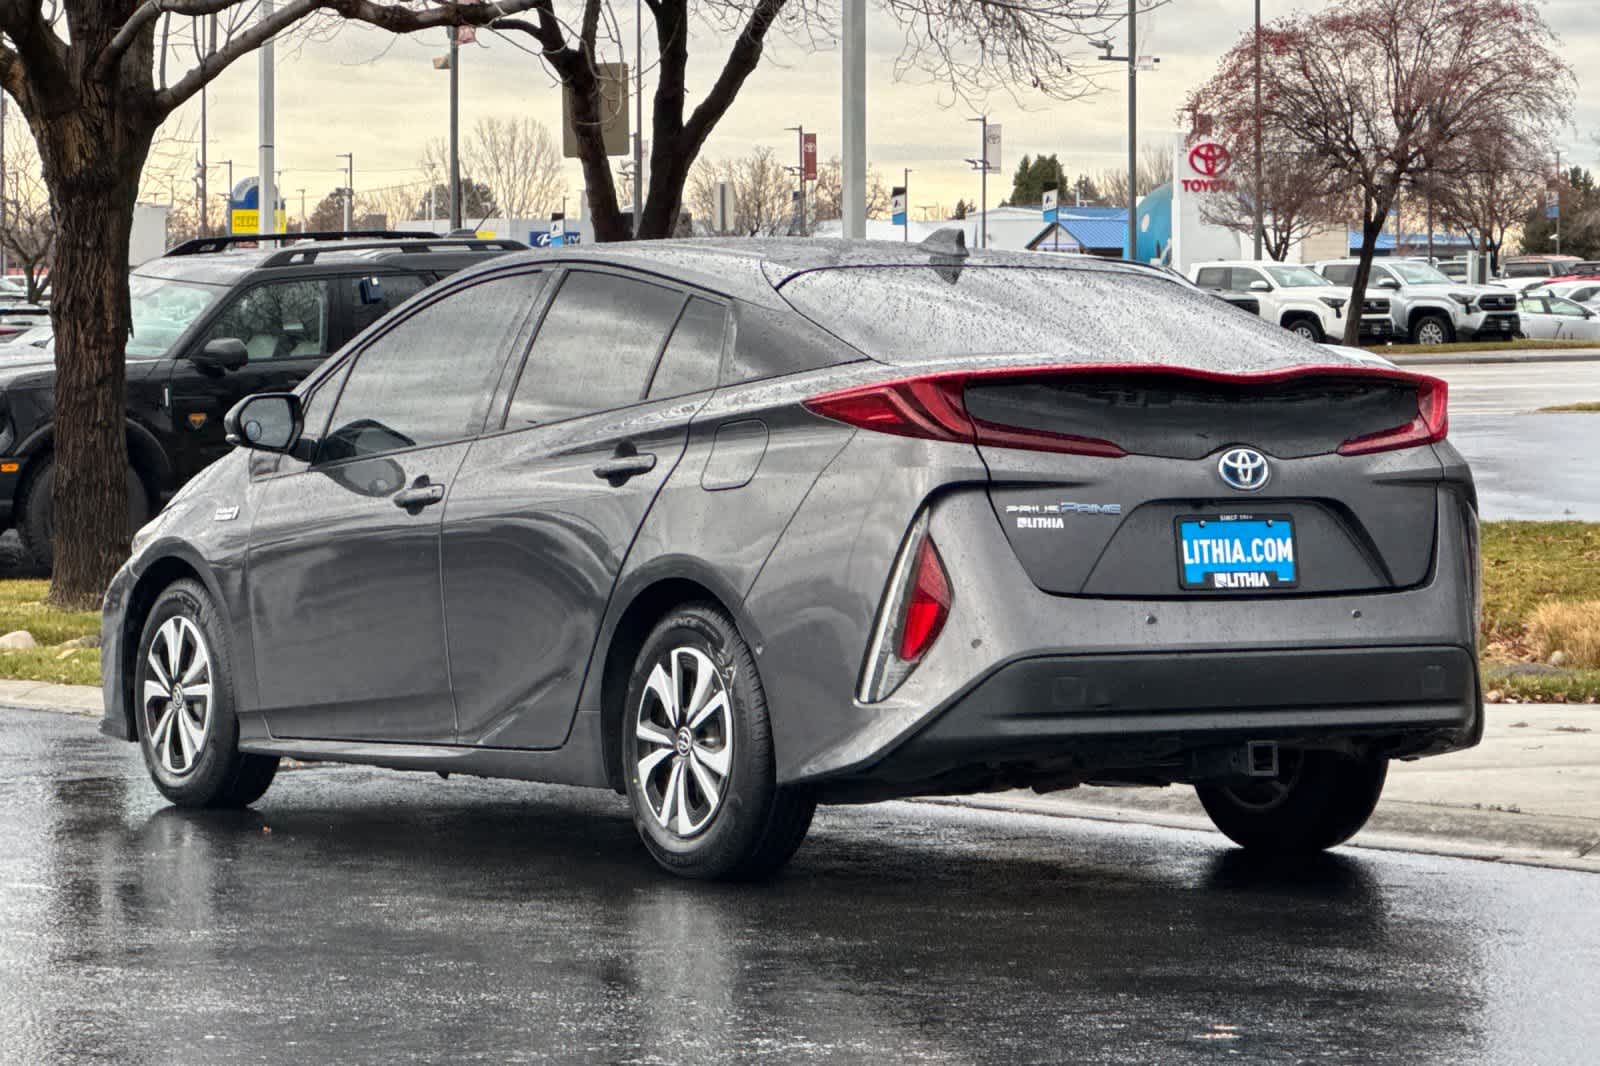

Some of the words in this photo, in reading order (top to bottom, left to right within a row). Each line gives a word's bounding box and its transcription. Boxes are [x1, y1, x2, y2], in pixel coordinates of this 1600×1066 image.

[1060, 502, 1121, 514] PRIME
[1027, 517, 1064, 529] LITHIA
[1182, 537, 1294, 564] LITHIA.COM
[1226, 572, 1270, 588] LITHIA
